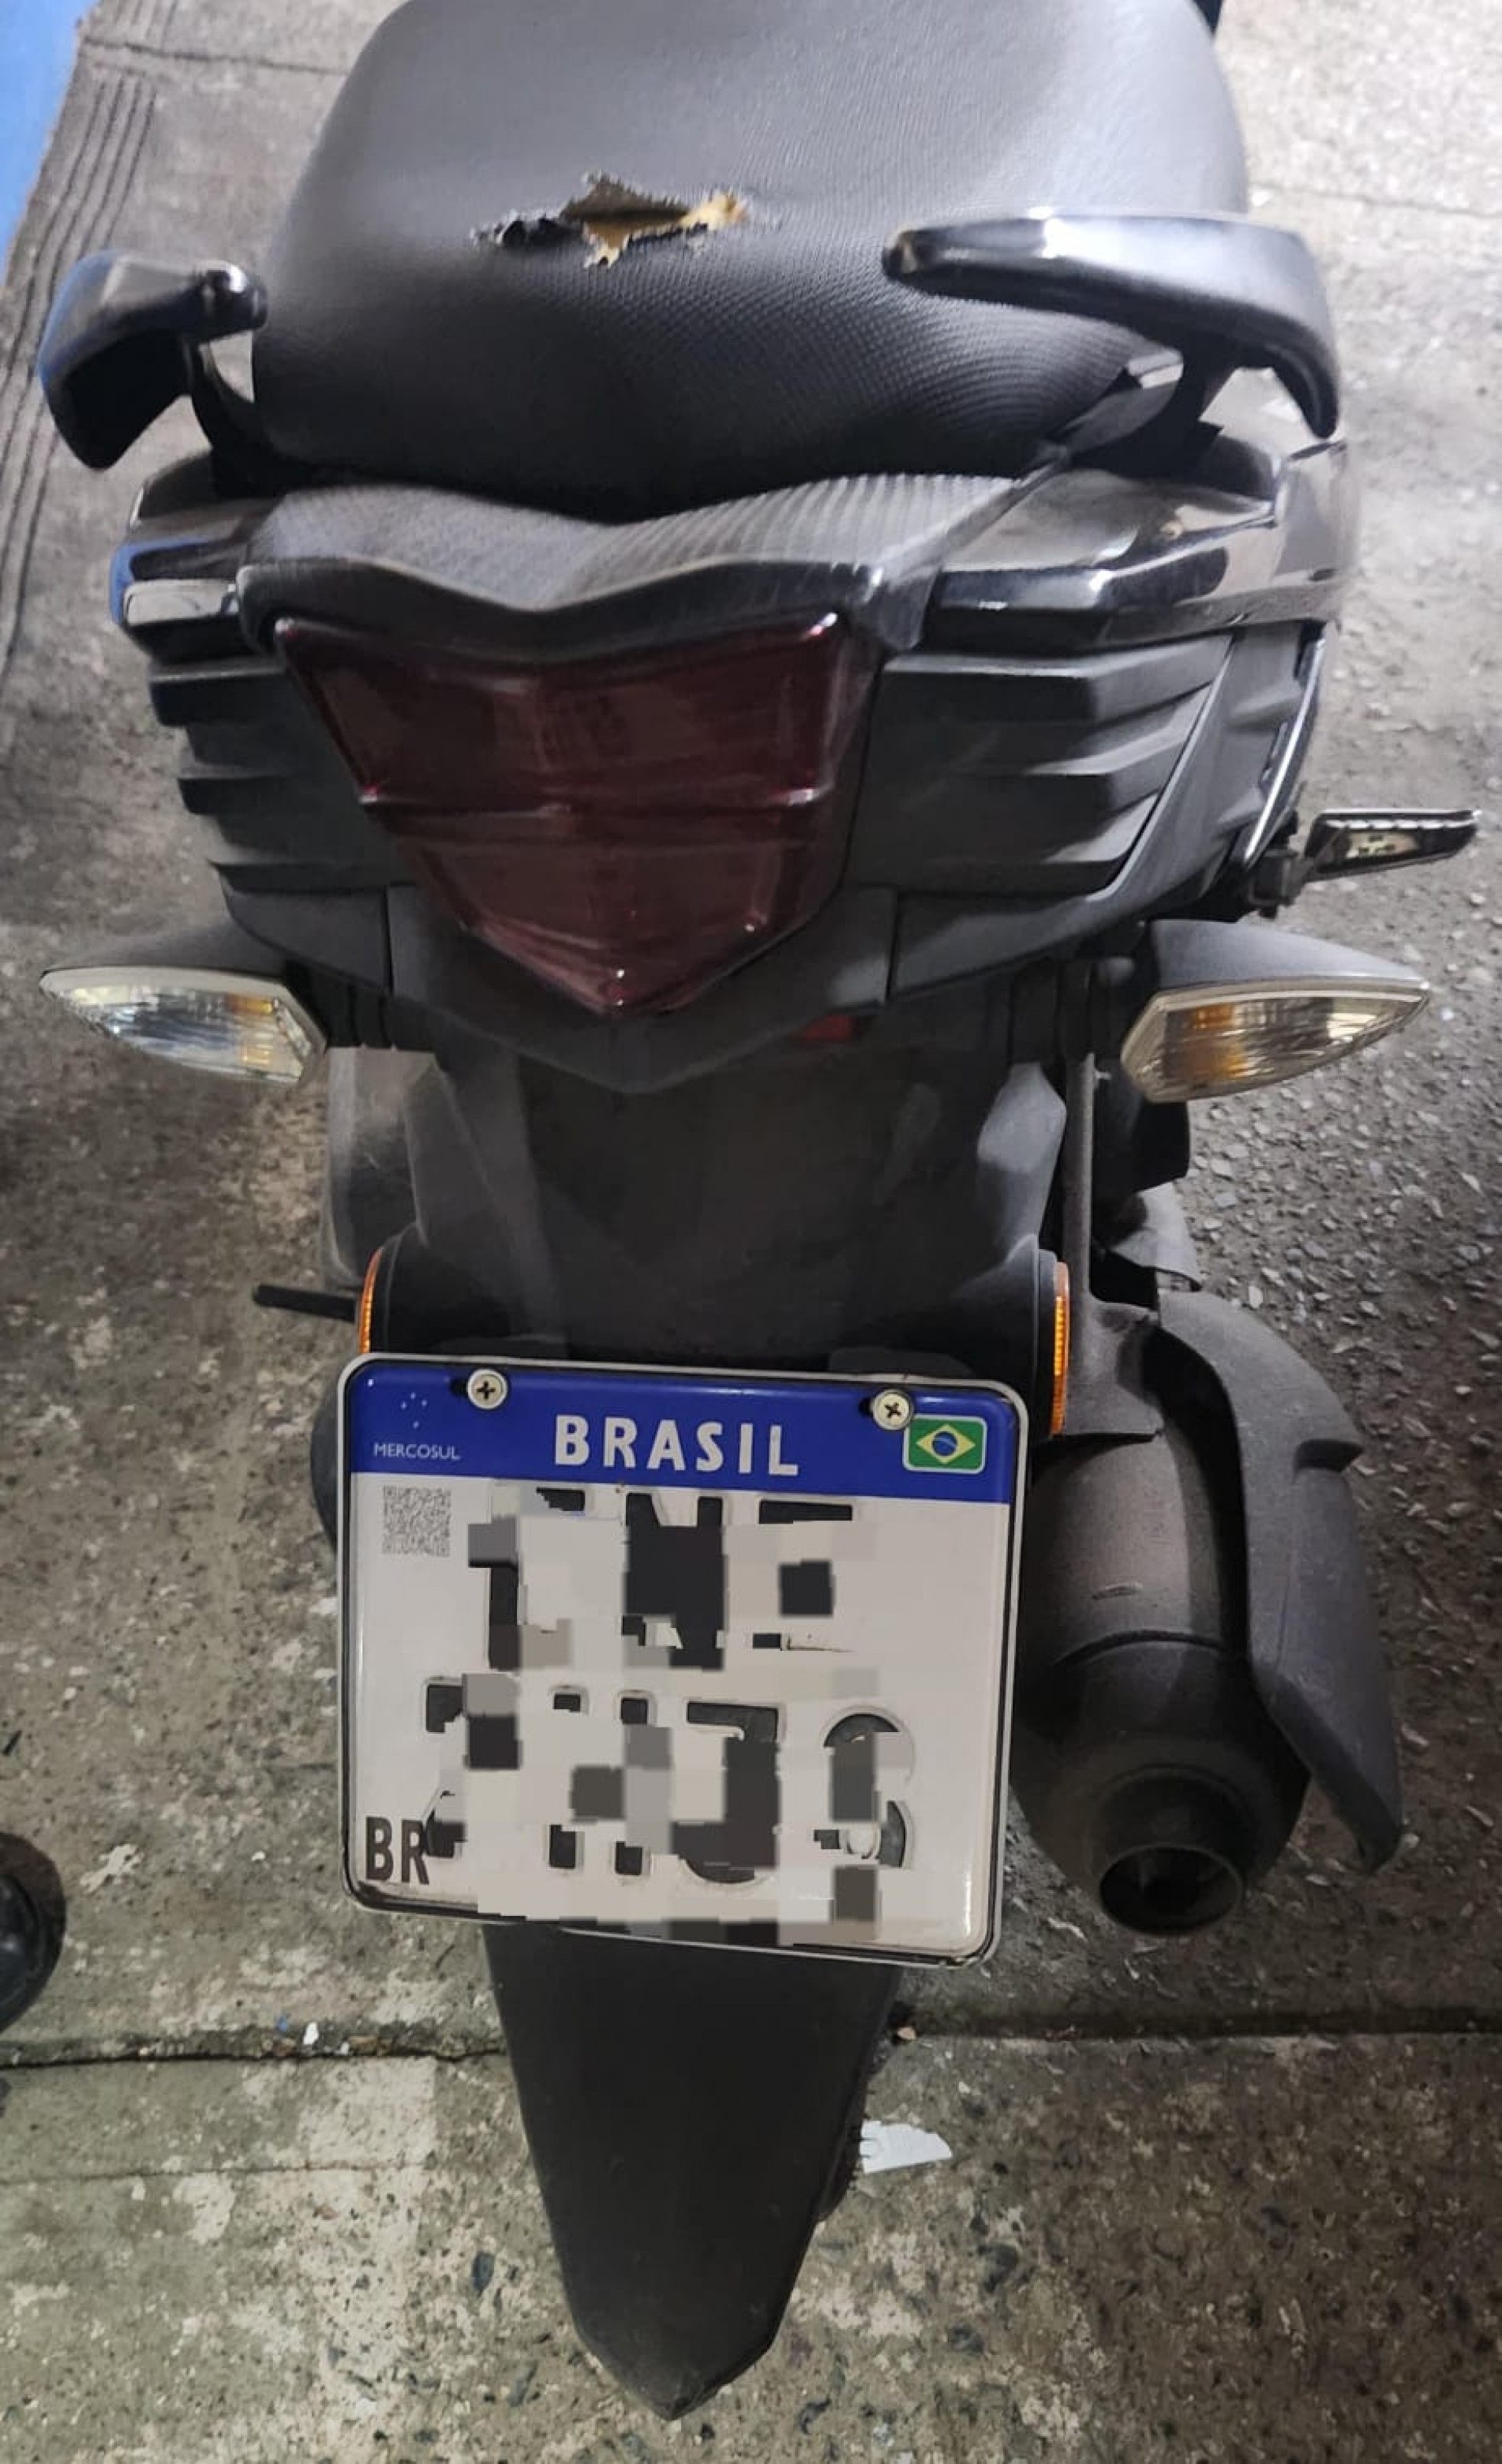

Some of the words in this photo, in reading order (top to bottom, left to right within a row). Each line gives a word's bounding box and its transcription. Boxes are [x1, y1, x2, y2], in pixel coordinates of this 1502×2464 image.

[373, 1442, 461, 1460] MERCOSUL
[555, 1414, 799, 1476] BRASIL
[366, 1816, 429, 1885] BR
